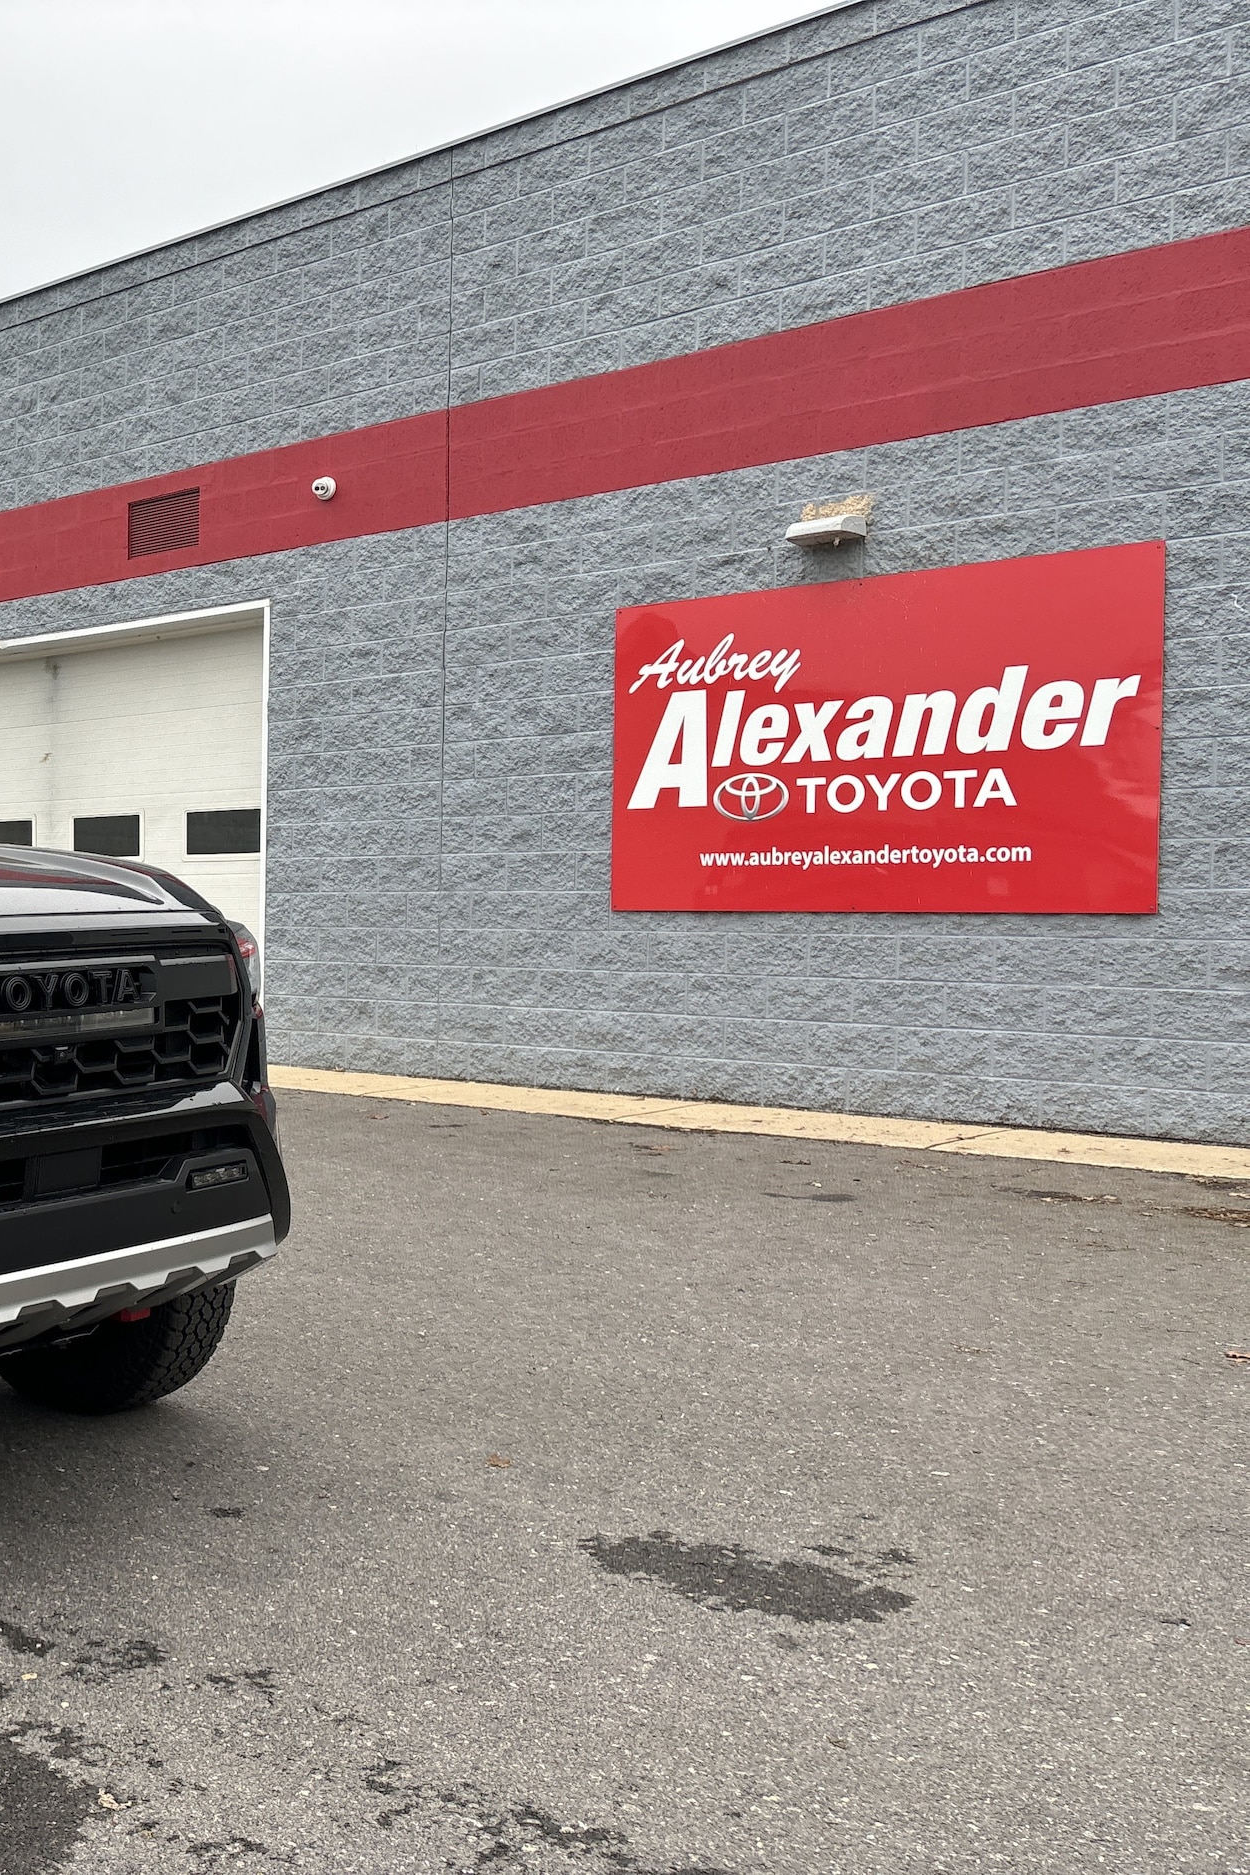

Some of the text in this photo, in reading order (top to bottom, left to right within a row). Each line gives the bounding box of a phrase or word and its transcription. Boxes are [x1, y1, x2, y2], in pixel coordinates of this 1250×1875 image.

[628, 632, 801, 694] Aubrey
[626, 664, 1142, 810] Alexander
[796, 767, 1018, 814] TOYOTA
[699, 844, 1033, 871] www.aubreyalexandertoyota.com
